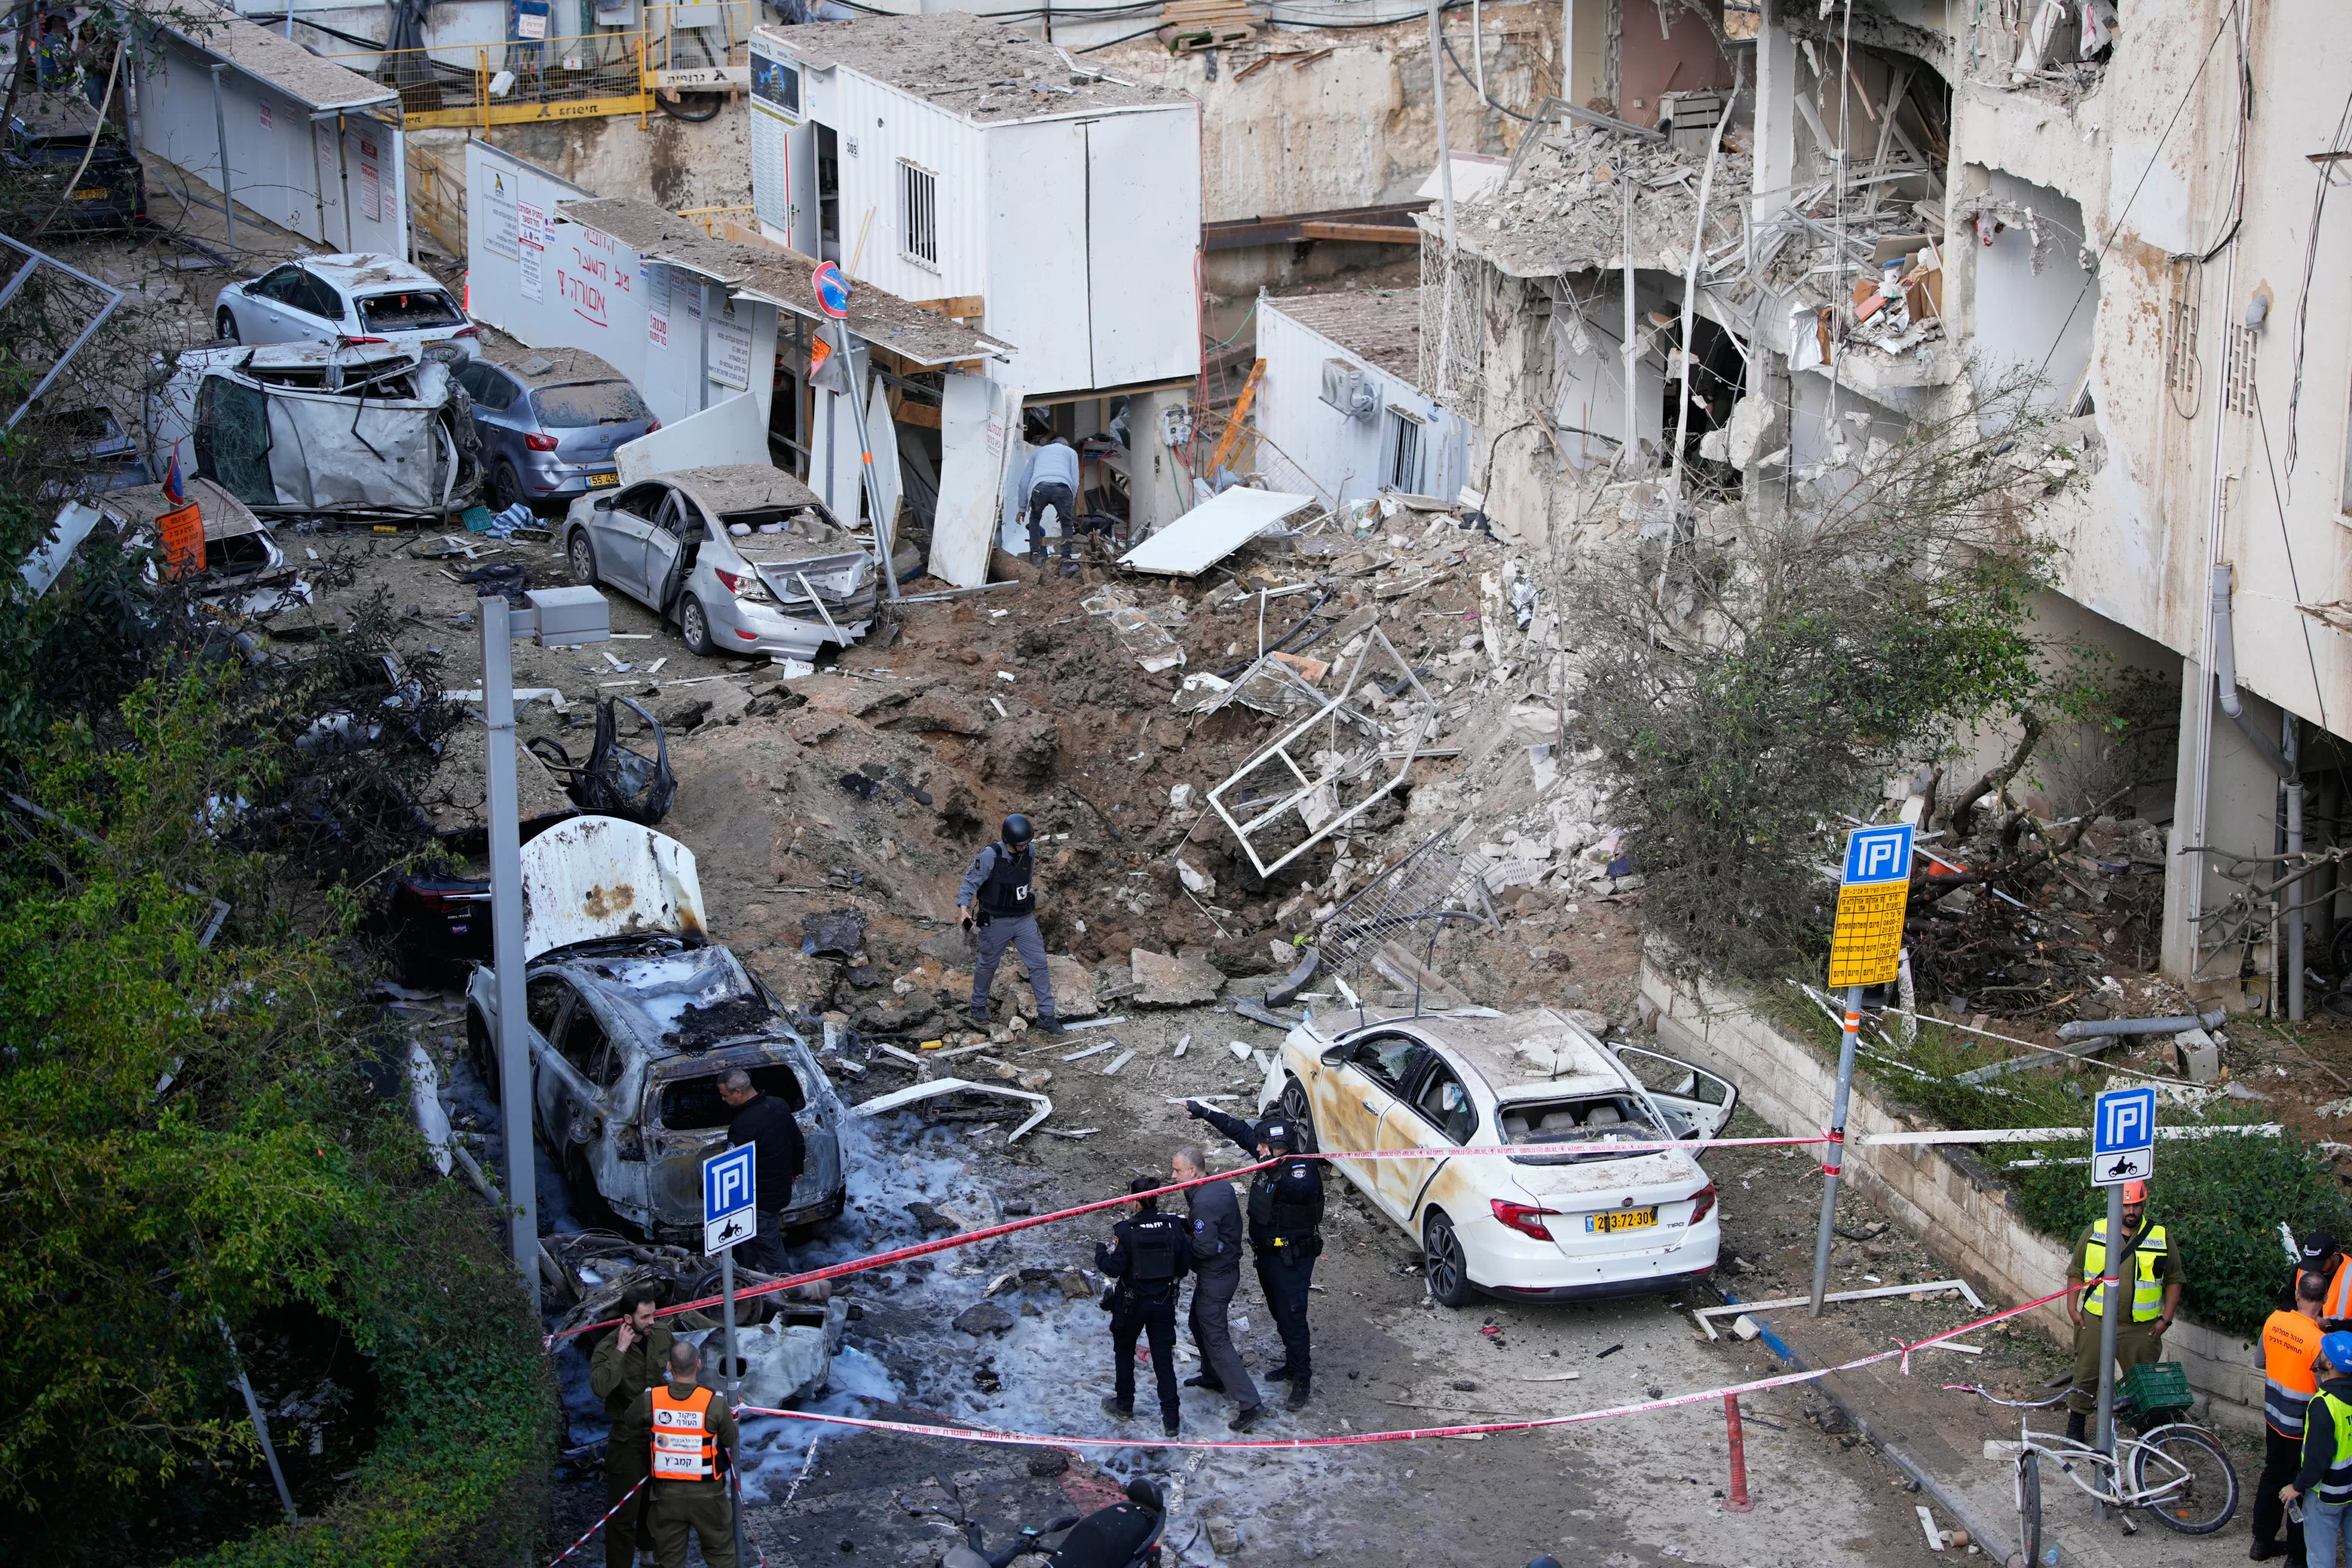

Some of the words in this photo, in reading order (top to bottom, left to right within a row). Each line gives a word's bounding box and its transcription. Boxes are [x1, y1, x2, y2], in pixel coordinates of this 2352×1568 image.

[668, 70, 705, 83] גרופית
[847, 142, 858, 155] 305
[573, 247, 606, 282] השער
[615, 265, 629, 292] מול
[557, 270, 606, 318] אסורה!
[650, 314, 667, 334] סכנה!
[649, 330, 659, 341] פתוח
[2272, 1326, 2289, 1338] מחלקת
[2269, 1335, 2282, 1345] דרכים
[2290, 1333, 2304, 1344] מנהל
[2283, 1342, 2302, 1355] תחזוקת
[906, 1425, 931, 1433] ישראל
[942, 1428, 972, 1437] משטרת
[978, 1431, 999, 1439] מעבר
[999, 1432, 1011, 1441] אין
[665, 1456, 692, 1468] קמב"ץ
